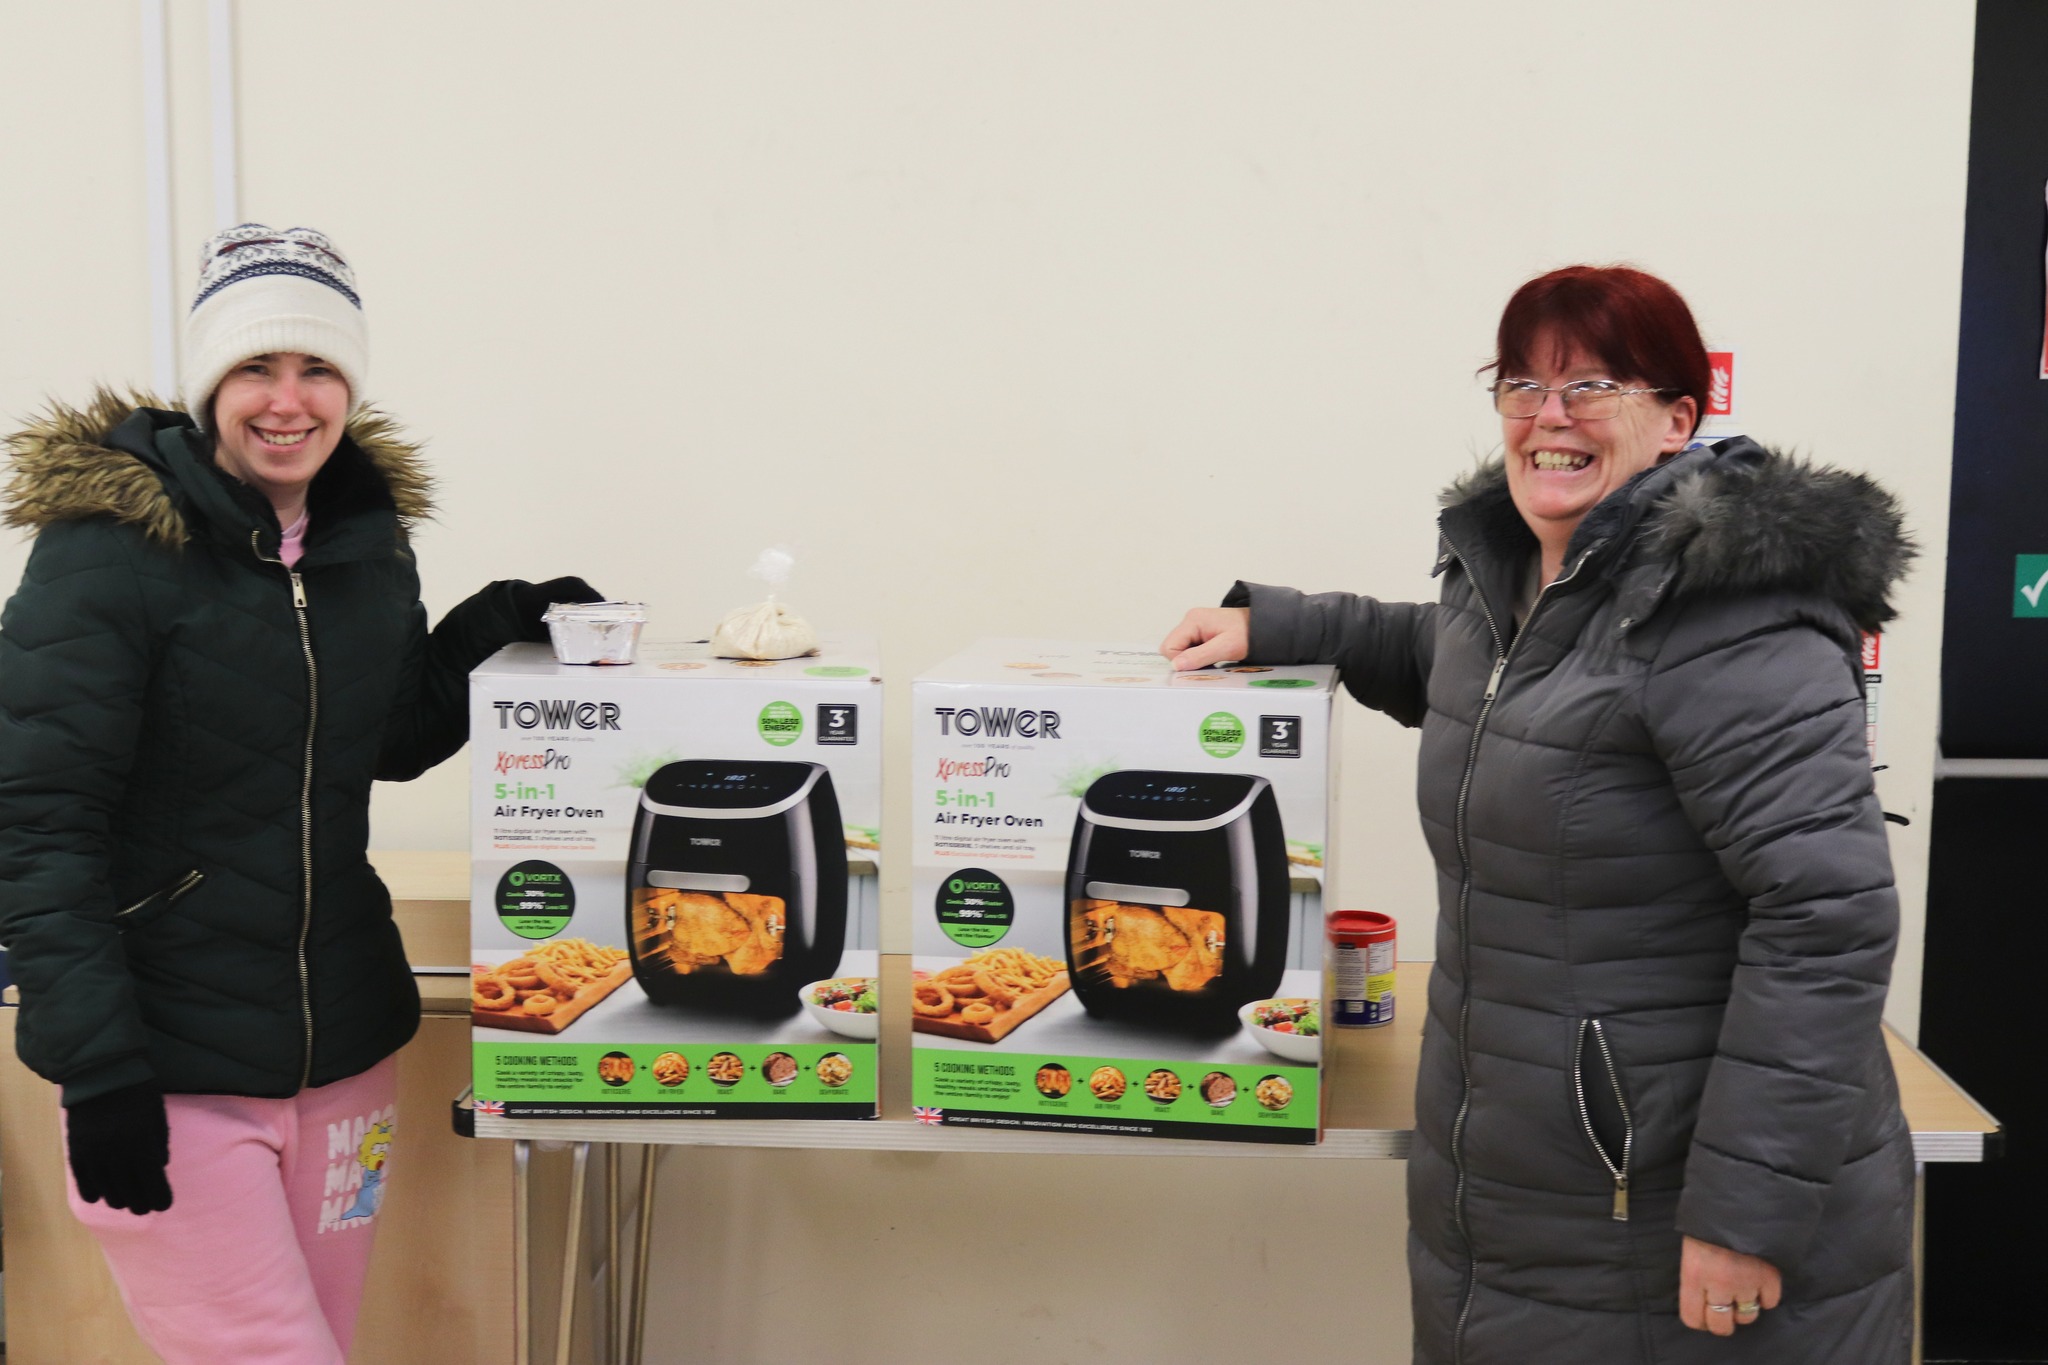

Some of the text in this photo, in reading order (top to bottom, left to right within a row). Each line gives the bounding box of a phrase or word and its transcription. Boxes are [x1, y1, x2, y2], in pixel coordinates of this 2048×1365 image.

[493, 700, 621, 730] TOWER
[934, 707, 1061, 739] TOWER
[494, 782, 555, 800] 5-in-1
[935, 789, 995, 808] 5-in-1
[494, 805, 604, 820] Air Fryer Oven
[936, 812, 1043, 827] Air Fryer Oven
[964, 882, 1000, 890] VORTX
[496, 1056, 577, 1066] 5 COOKING METHODS
[934, 1062, 1014, 1076] 5 COOKING METHODS
